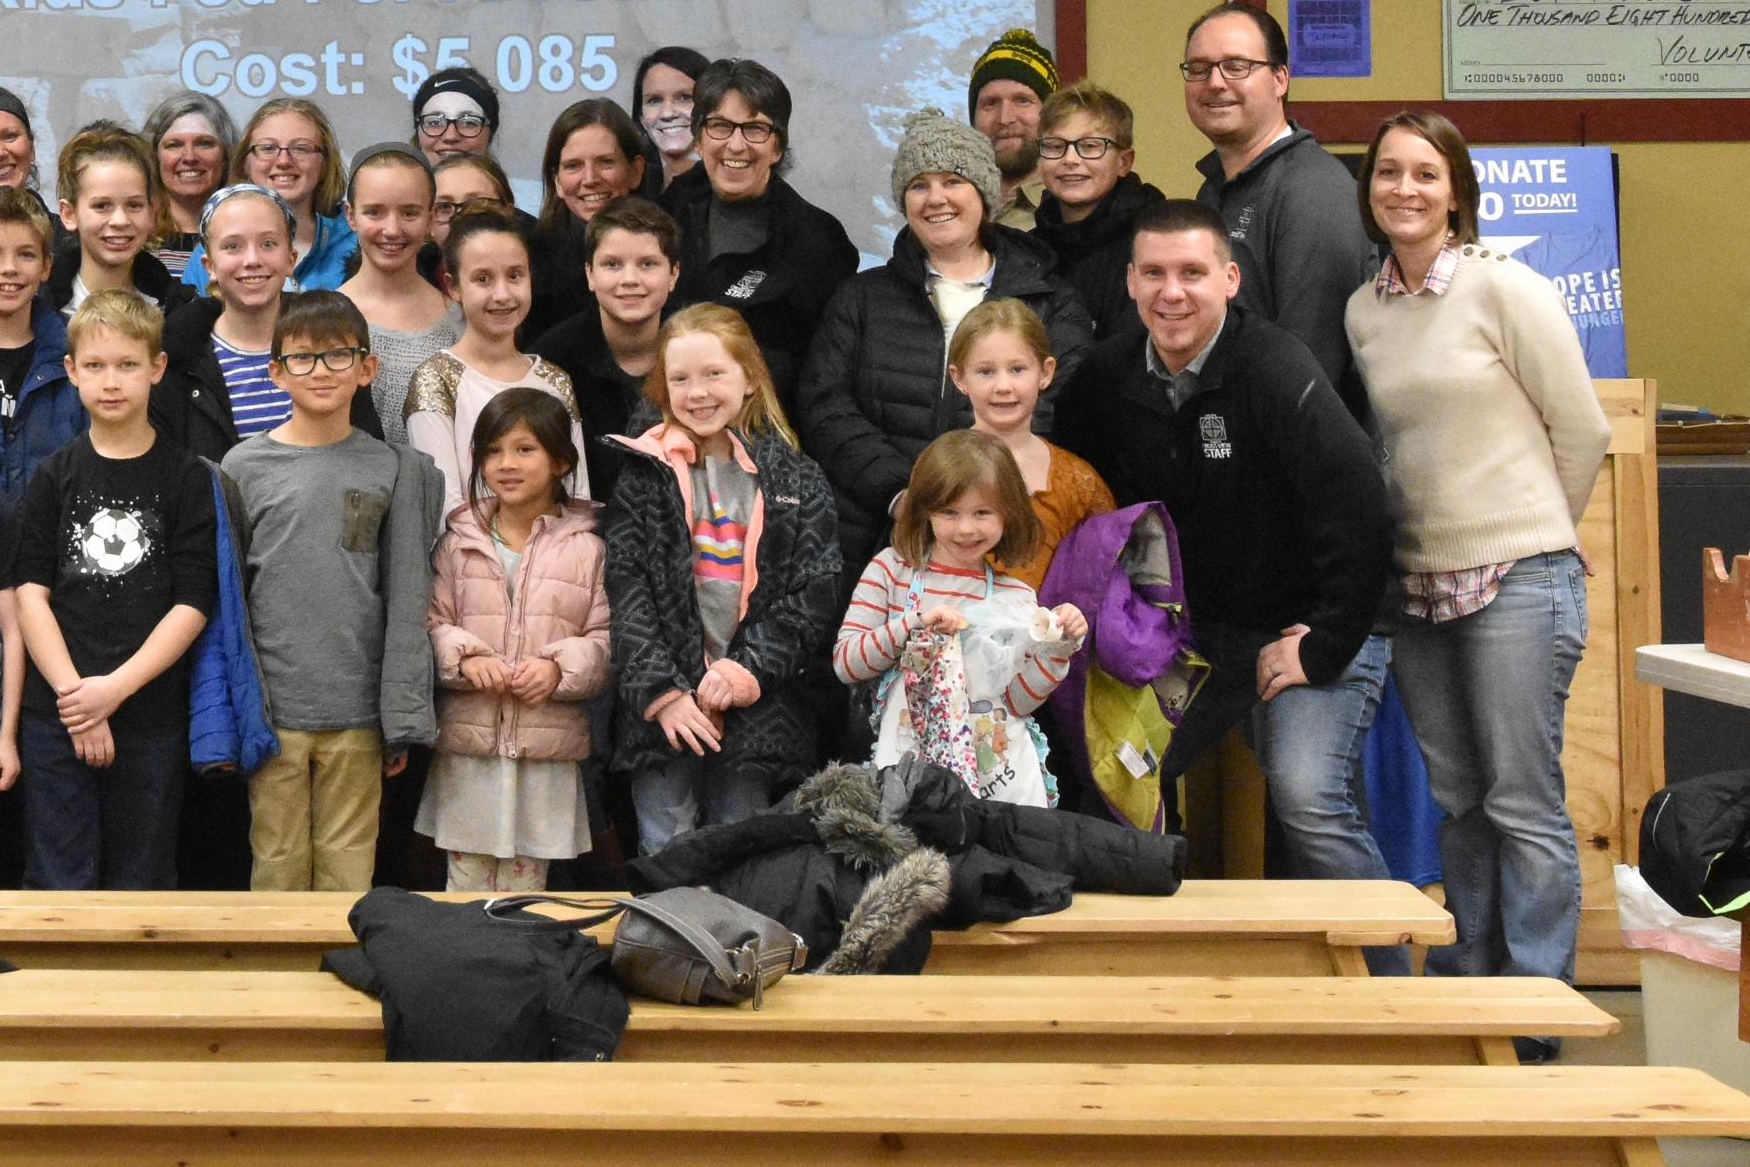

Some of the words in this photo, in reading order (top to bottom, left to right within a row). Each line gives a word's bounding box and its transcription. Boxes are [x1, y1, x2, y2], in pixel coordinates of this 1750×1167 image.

[1456, 3, 1503, 27] ONE
[1507, 4, 1602, 27] THOUSAND
[1605, 7, 1672, 27] EIGHT
[181, 39, 364, 97] Cost:
[391, 34, 618, 99] $5085
[1511, 193, 1578, 208] TODAY!
[1601, 268, 1621, 290] IS
[1203, 448, 1232, 459] STAFF
